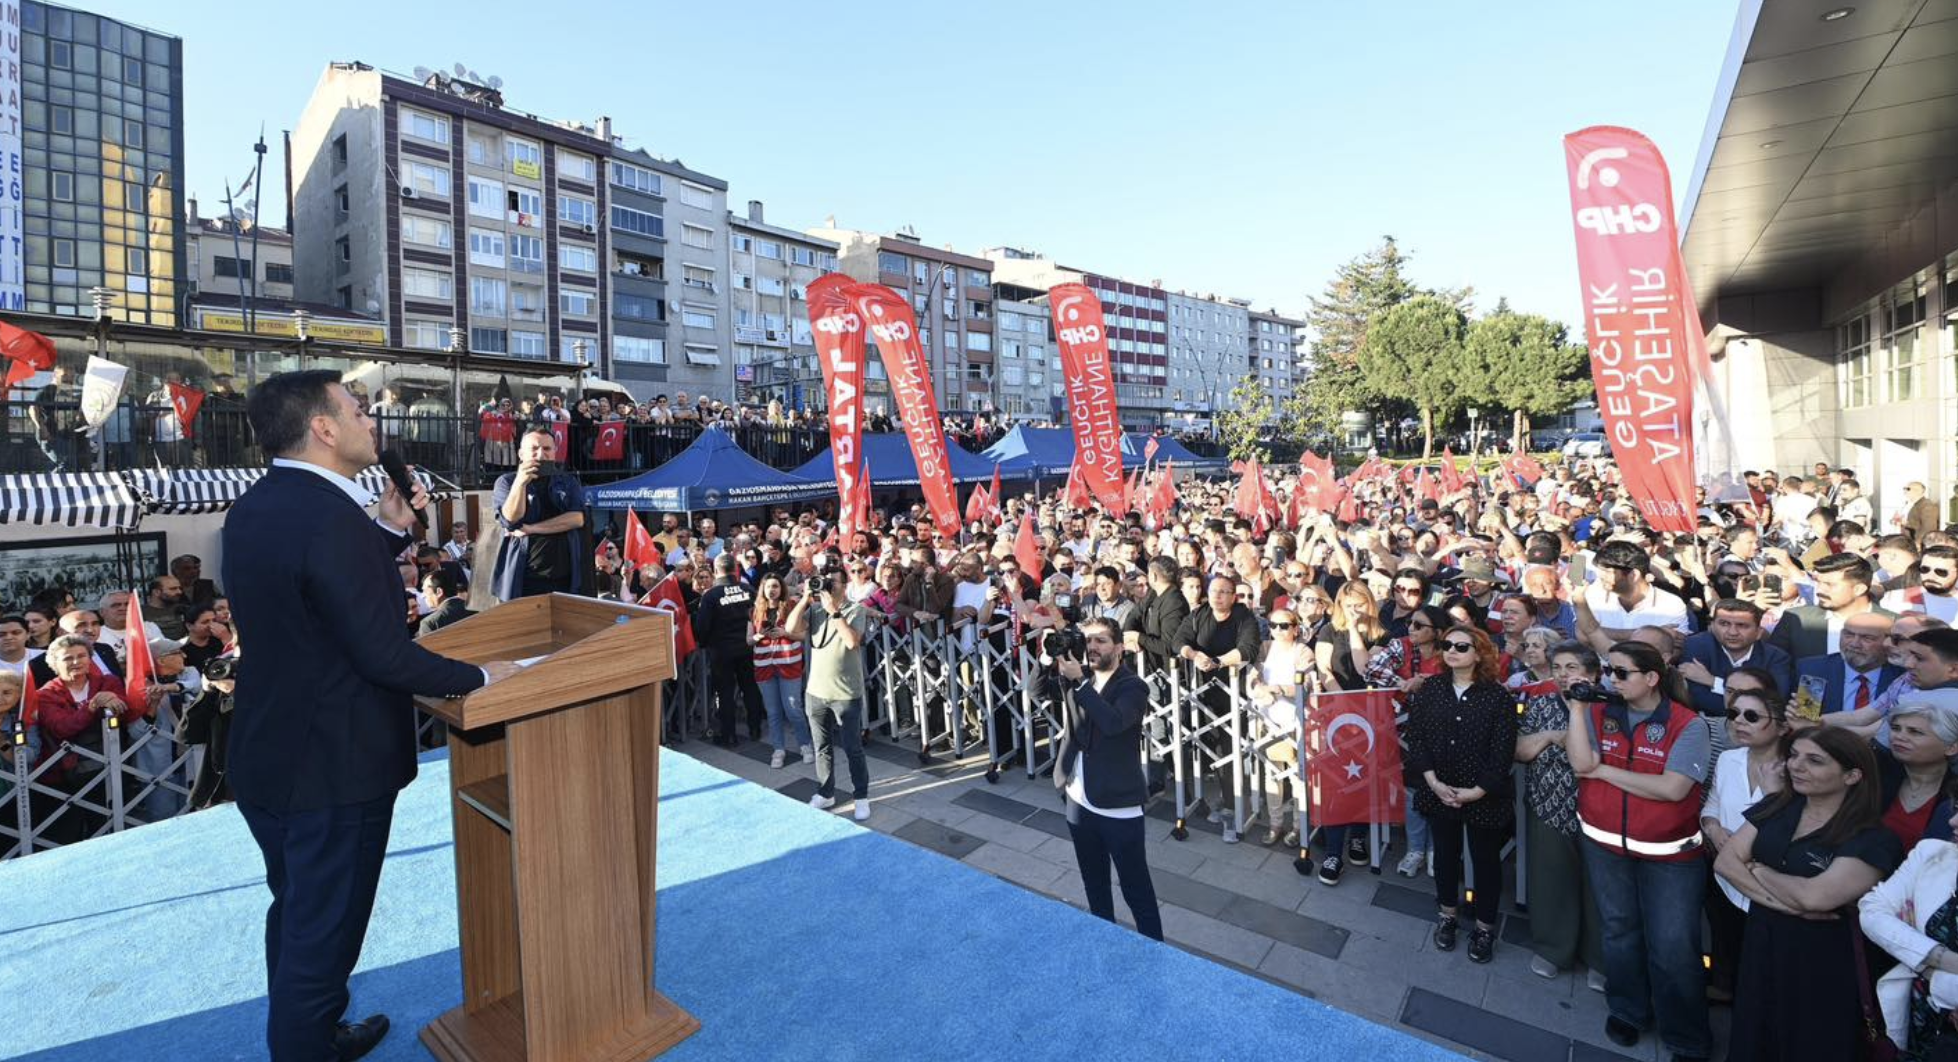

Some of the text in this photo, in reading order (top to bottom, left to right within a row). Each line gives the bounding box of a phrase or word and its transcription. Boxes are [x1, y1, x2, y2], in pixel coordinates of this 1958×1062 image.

[7, 4, 23, 312] MURAT EĞİTİM
[723, 585, 744, 595] ÖZEL
[1637, 746, 1664, 757] POLİS
